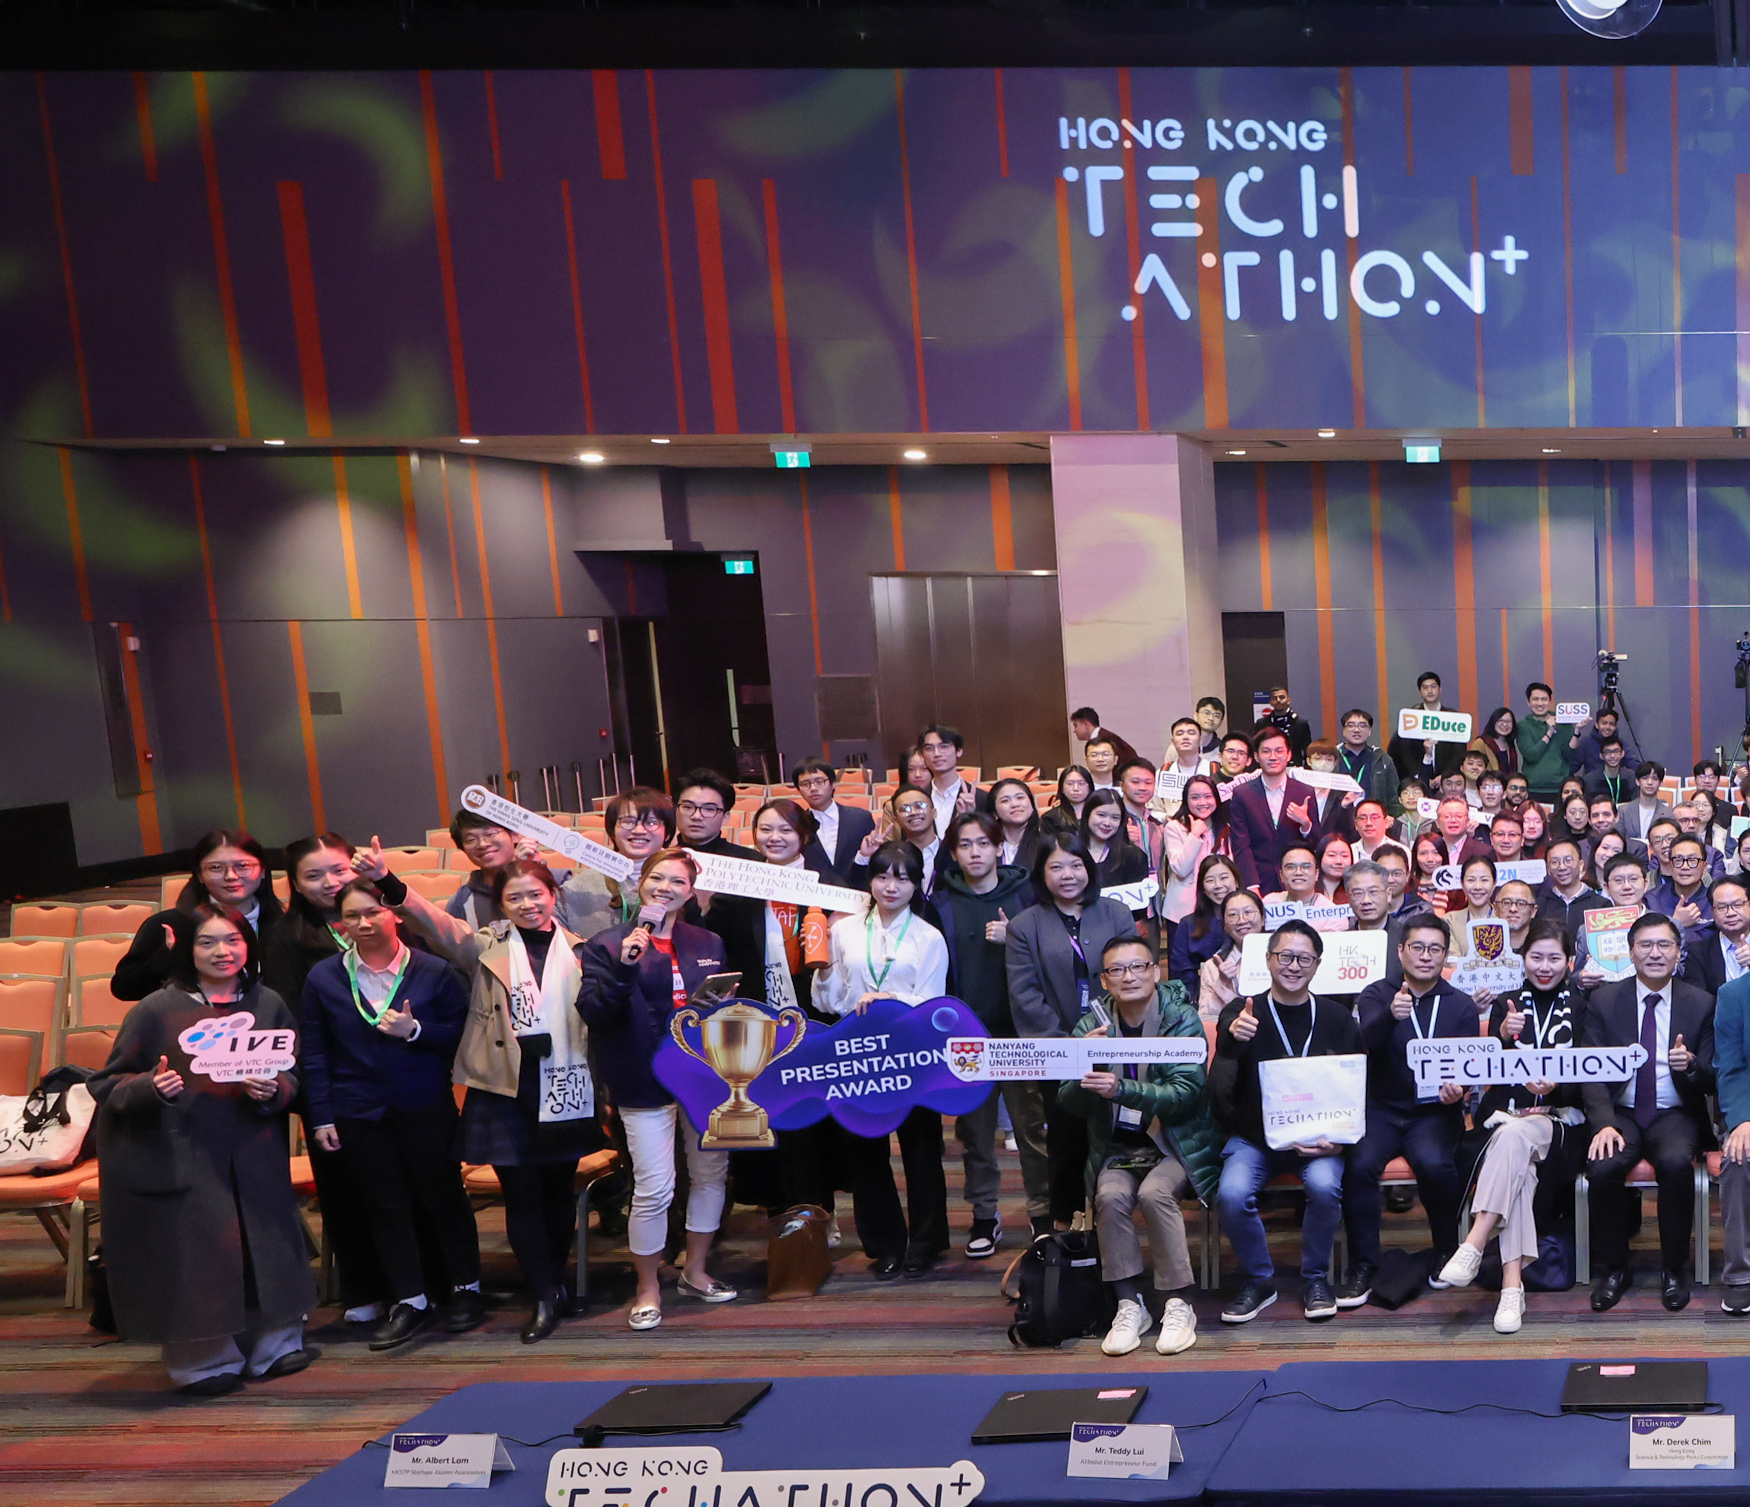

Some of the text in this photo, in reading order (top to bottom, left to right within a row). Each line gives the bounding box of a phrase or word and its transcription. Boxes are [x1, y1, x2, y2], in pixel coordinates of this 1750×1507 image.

[1059, 117, 1328, 152] HONG KONG
[1062, 164, 1360, 238] TECH
[1558, 704, 1588, 714] SUSS
[522, 821, 549, 837] UNIVERSITY
[708, 857, 814, 883] THE HONG KONG
[702, 878, 776, 898] 香港理工大學
[706, 868, 866, 904] POLYTECHNIC UNIVERSITY
[1265, 904, 1296, 918] NUS
[1338, 945, 1359, 955] HK
[1338, 966, 1368, 980] 300
[230, 1036, 288, 1052] IVE
[834, 1034, 890, 1056] BEST
[1413, 1044, 1495, 1054] HONG KONG
[990, 1050, 1068, 1058] TECHNOLOGICAL
[1088, 1050, 1203, 1060] Entrepreneurship Academy
[264, 1058, 289, 1066] Group
[780, 1048, 948, 1085] PRESENTATION
[989, 1058, 1046, 1066] UNIVERSITY
[826, 1074, 912, 1100] AWARD
[1652, 1438, 1712, 1446] Mr. Derek Chim
[1108, 1448, 1131, 1456] Teddy
[560, 1458, 709, 1480] HONG KONG
[1104, 1459, 1140, 1468] Entrepreneur
